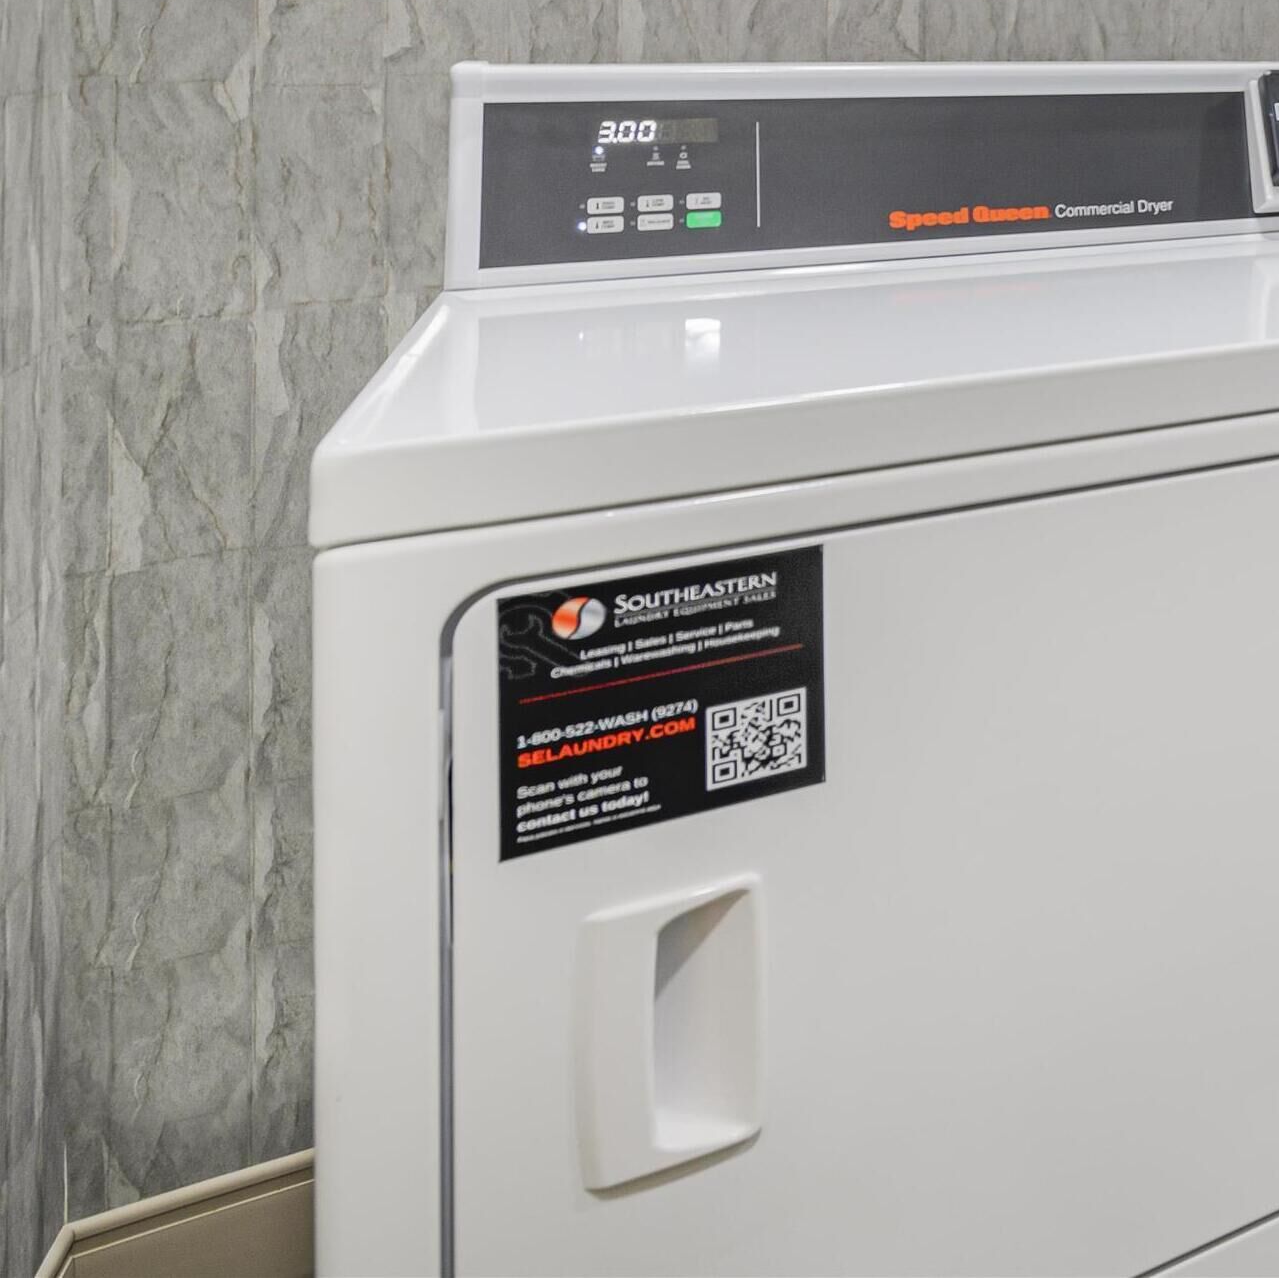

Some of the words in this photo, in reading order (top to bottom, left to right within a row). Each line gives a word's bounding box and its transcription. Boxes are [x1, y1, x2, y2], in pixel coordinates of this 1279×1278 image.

[598, 120, 657, 144] 3.00
[889, 206, 970, 231] Speed
[972, 205, 1051, 223] Queen
[1054, 201, 1135, 219] Commercial
[1137, 199, 1175, 215] Dryer
[613, 571, 778, 615] SOUTHEASTERN
[675, 626, 717, 643] Service
[725, 619, 754, 633] Parts
[517, 709, 649, 749] 1-800-522-WASH
[651, 699, 699, 722] (9274)
[517, 716, 696, 768] SELAUNDRY.COM
[516, 793, 575, 819] phone's
[577, 780, 632, 802] camera
[633, 776, 649, 789] to
[517, 781, 556, 800] Scan
[557, 773, 589, 790] with
[590, 765, 623, 784] your
[516, 809, 577, 833] contact
[578, 804, 599, 818] us
[601, 791, 650, 813] today!
